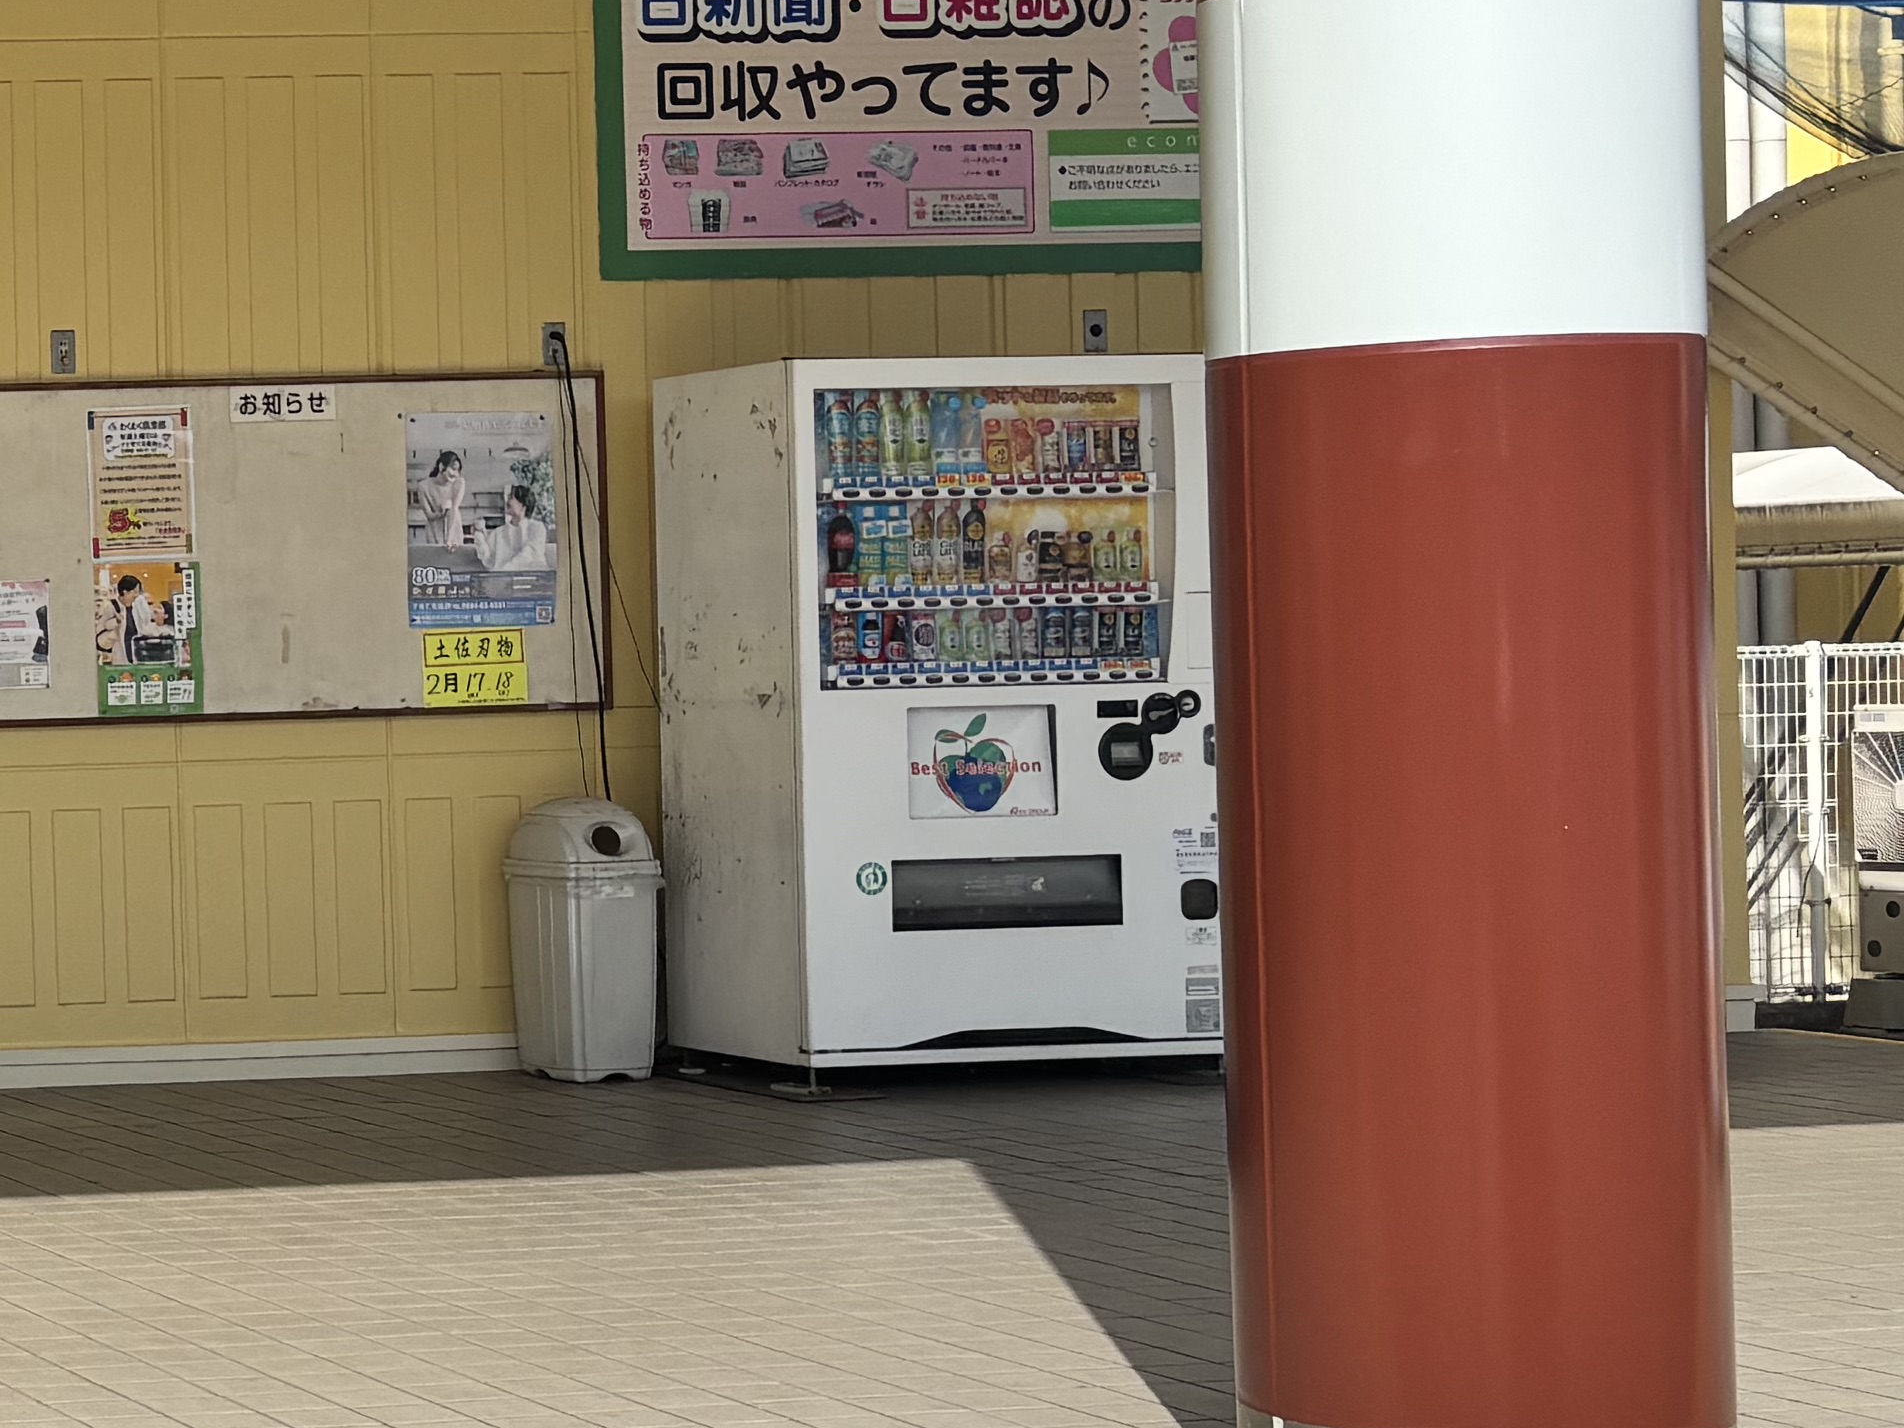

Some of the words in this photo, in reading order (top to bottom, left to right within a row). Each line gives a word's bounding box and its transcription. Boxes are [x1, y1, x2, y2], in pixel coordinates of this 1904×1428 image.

[238, 391, 327, 415] お知らせ
[433, 635, 514, 660] 土佐刃物
[910, 761, 949, 776] Best
[955, 759, 1042, 777] Selection
